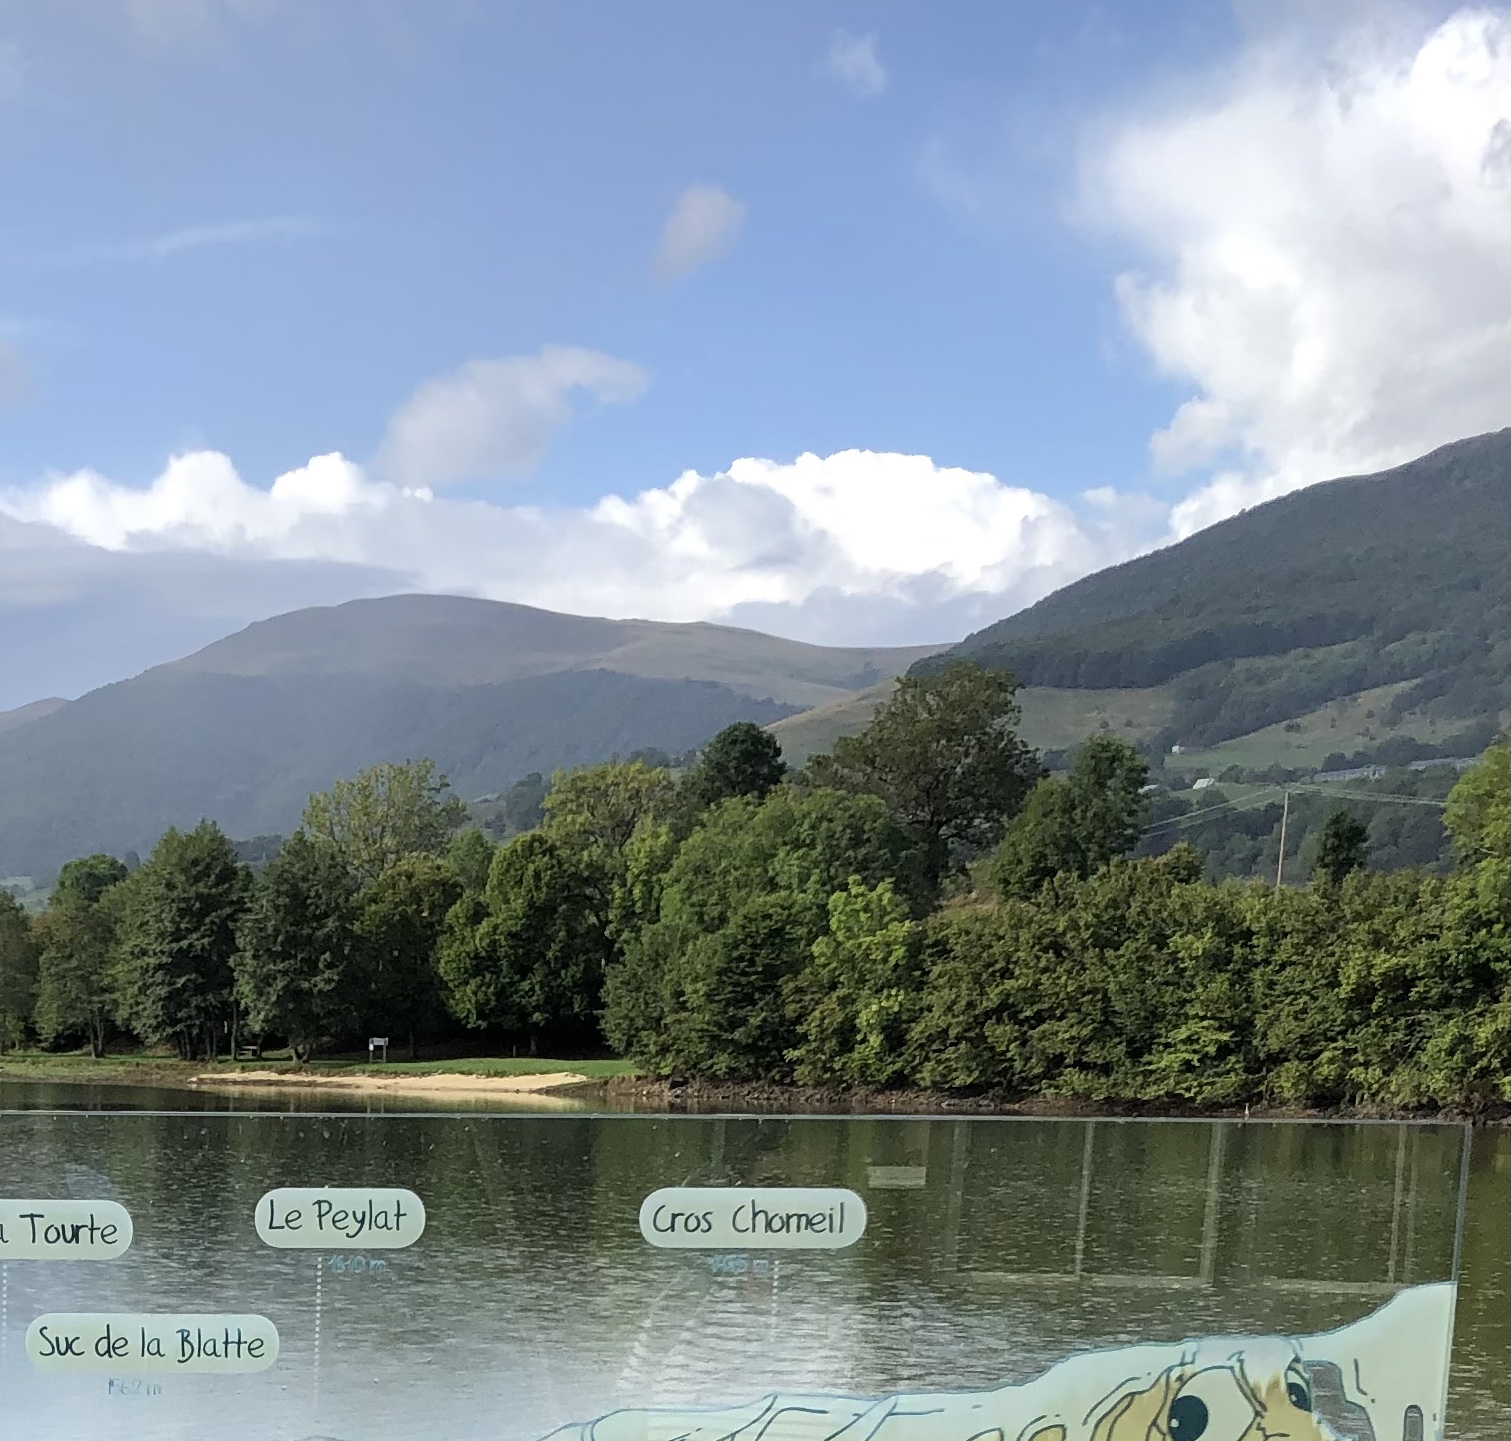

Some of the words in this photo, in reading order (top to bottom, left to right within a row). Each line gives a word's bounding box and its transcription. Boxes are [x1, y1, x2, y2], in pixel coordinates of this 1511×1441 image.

[19, 1212, 118, 1246] Tourte
[268, 1199, 303, 1230] Le
[312, 1199, 407, 1239] Peylat
[653, 1204, 713, 1234] Cros
[732, 1199, 845, 1234] Chomeil
[38, 1326, 85, 1358] Suc
[94, 1324, 129, 1359] de
[140, 1327, 166, 1359] la
[176, 1329, 265, 1364] Blatte
